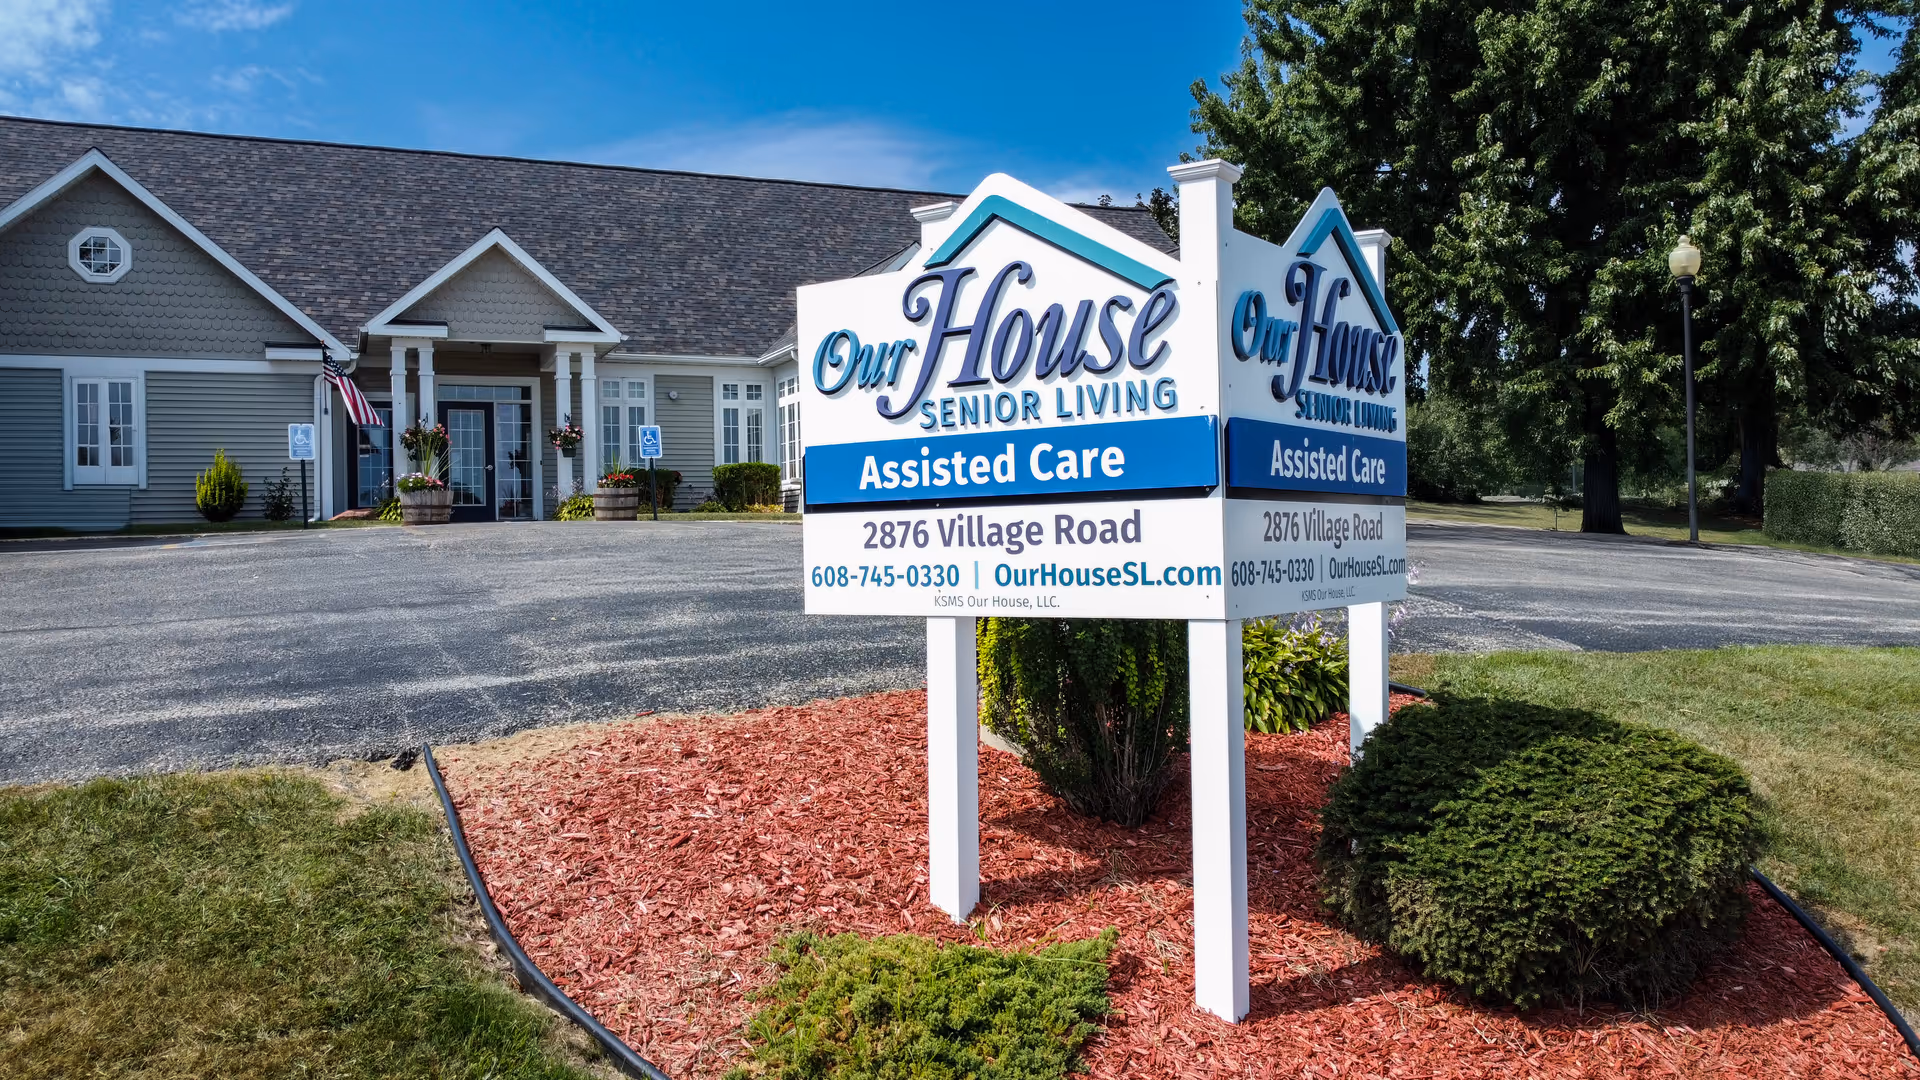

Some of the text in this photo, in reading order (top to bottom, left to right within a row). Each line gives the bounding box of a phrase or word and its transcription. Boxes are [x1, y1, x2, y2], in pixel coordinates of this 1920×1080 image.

[812, 260, 1178, 420] Our House
[1232, 261, 1398, 403] Our House
[920, 377, 1178, 430] SENIOR LIVING
[1295, 388, 1397, 434] SENIOR LIVING
[859, 442, 1126, 490] Assisted Care
[1270, 437, 1386, 485] Assisted Care
[863, 509, 1142, 555] 2876 Village Road
[1263, 508, 1383, 549] 2876 Village Road
[811, 561, 1222, 588] 608-745-0330 OurHouseSL.com
[1231, 555, 1406, 587] 608-745-0330 OurHouseSL.com
[1301, 589, 1316, 601] KSMS
[1317, 589, 1328, 600] Our
[1328, 587, 1345, 600] House,
[934, 595, 1061, 610] KSMS Our House, LLC.
